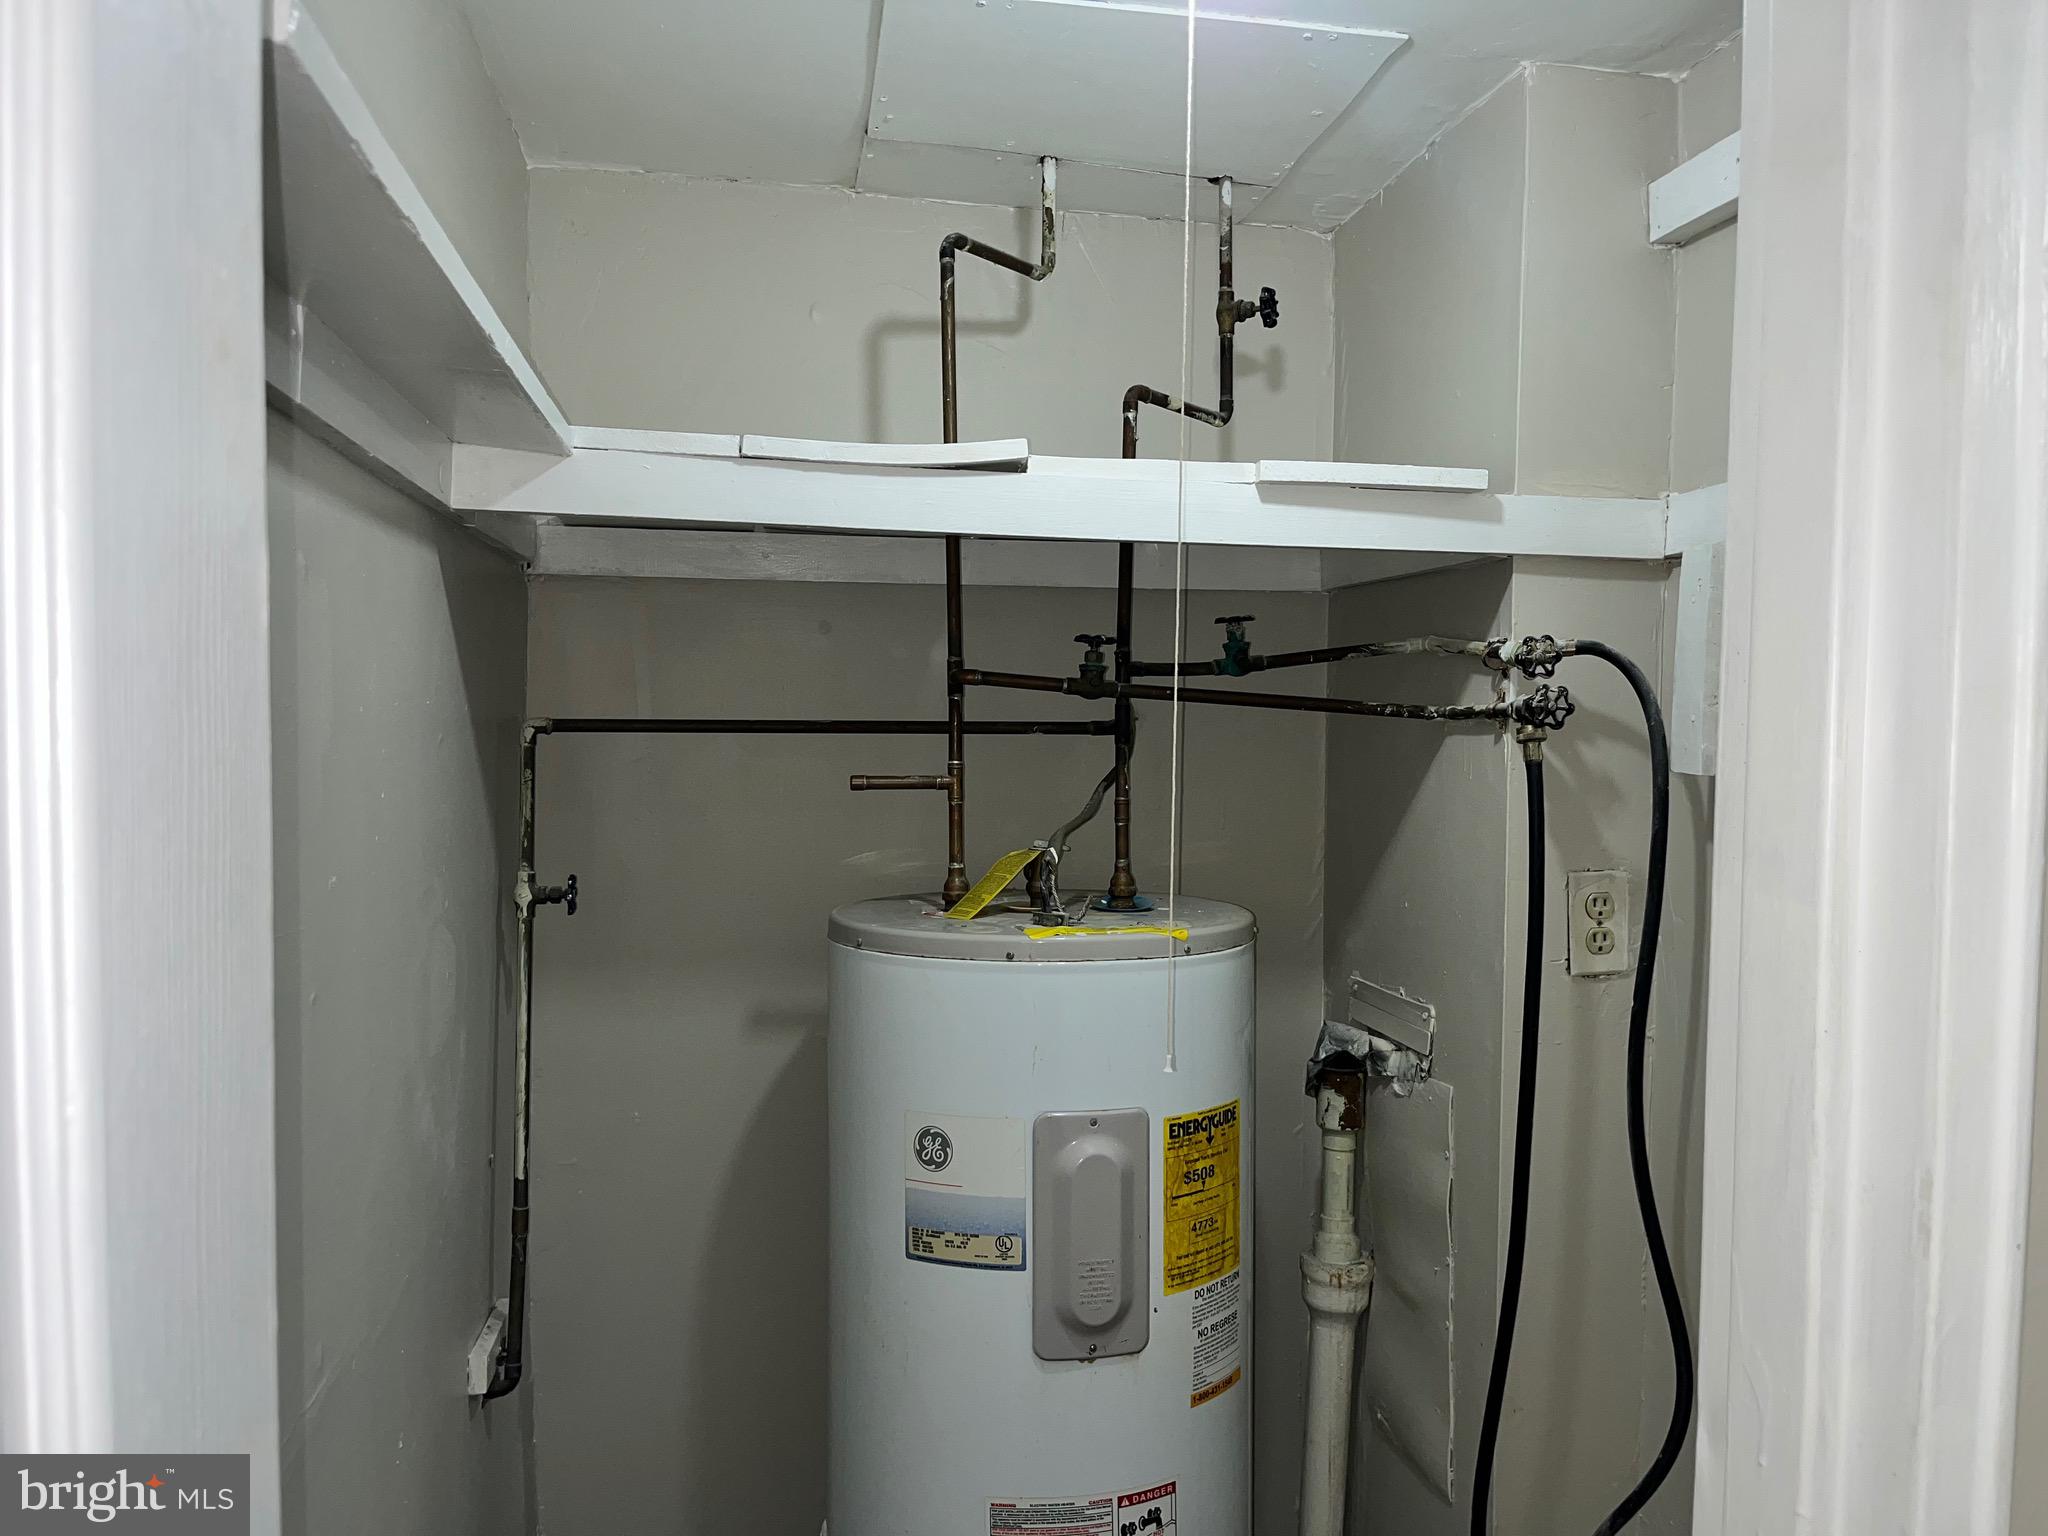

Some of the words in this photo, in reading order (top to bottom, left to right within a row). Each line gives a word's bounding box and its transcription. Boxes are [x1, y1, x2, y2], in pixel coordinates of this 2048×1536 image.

[922, 1135, 944, 1162] GE
[1184, 1164, 1215, 1185] $508
[1191, 1217, 1214, 1232] 4773
[1195, 1288, 1205, 1300] DO
[1206, 1281, 1219, 1295] NOT
[1220, 1268, 1240, 1288] RETURN
[1198, 1326, 1209, 1339] NO
[1210, 1309, 1238, 1334] REGRESE
[1132, 1484, 1174, 1504] DANGER
